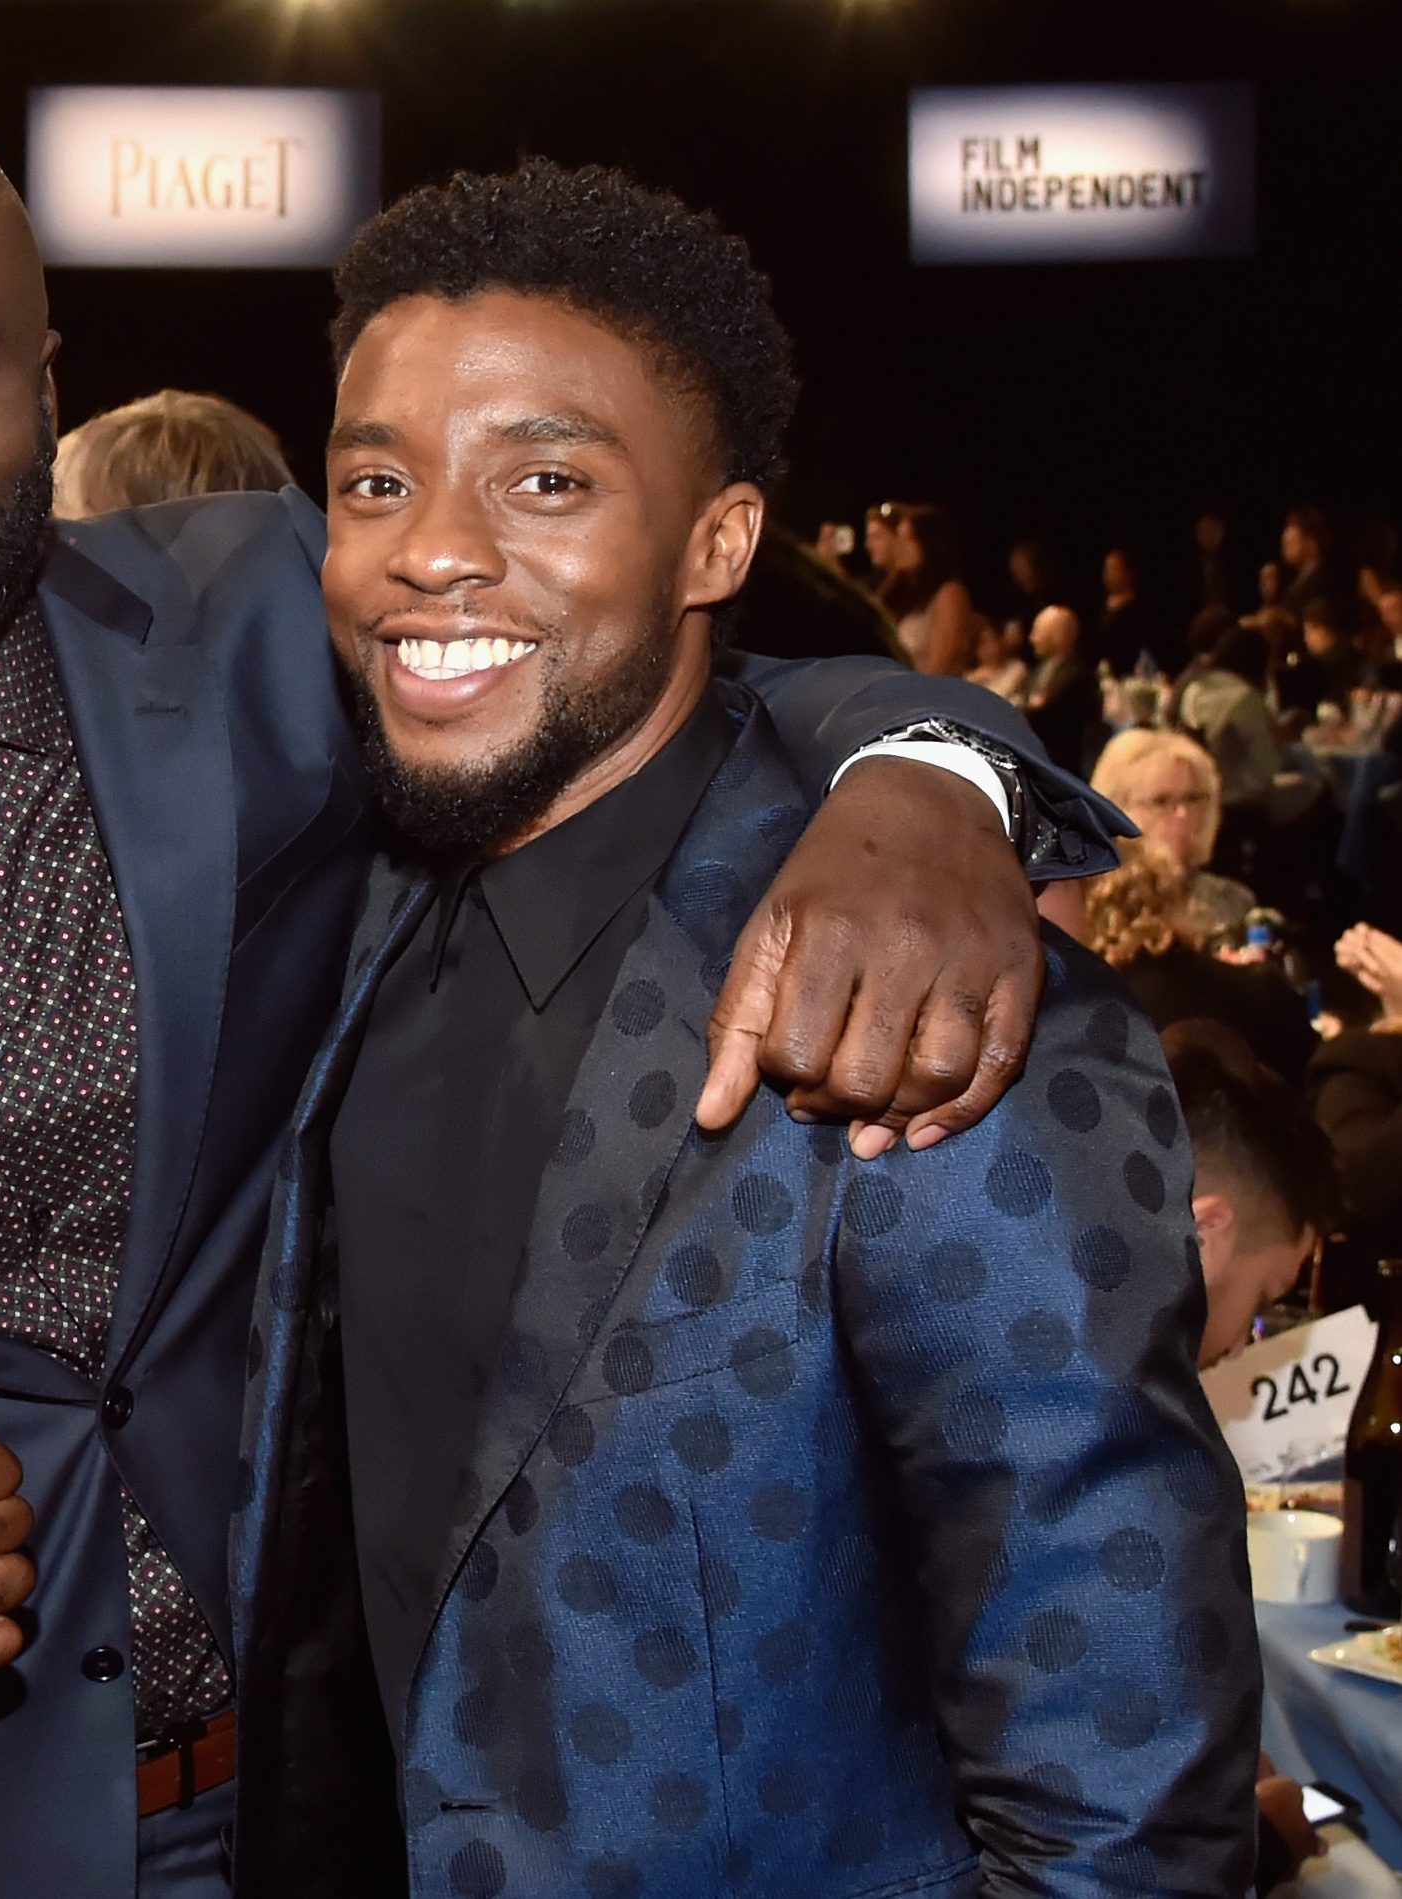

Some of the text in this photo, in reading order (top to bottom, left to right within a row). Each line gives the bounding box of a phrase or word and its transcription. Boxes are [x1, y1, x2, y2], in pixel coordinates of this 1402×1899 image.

[109, 134, 302, 217] PIAGET
[961, 136, 1040, 173] FILM
[961, 170, 1206, 212] INDEPENDENT
[1251, 1353, 1350, 1421] 242
